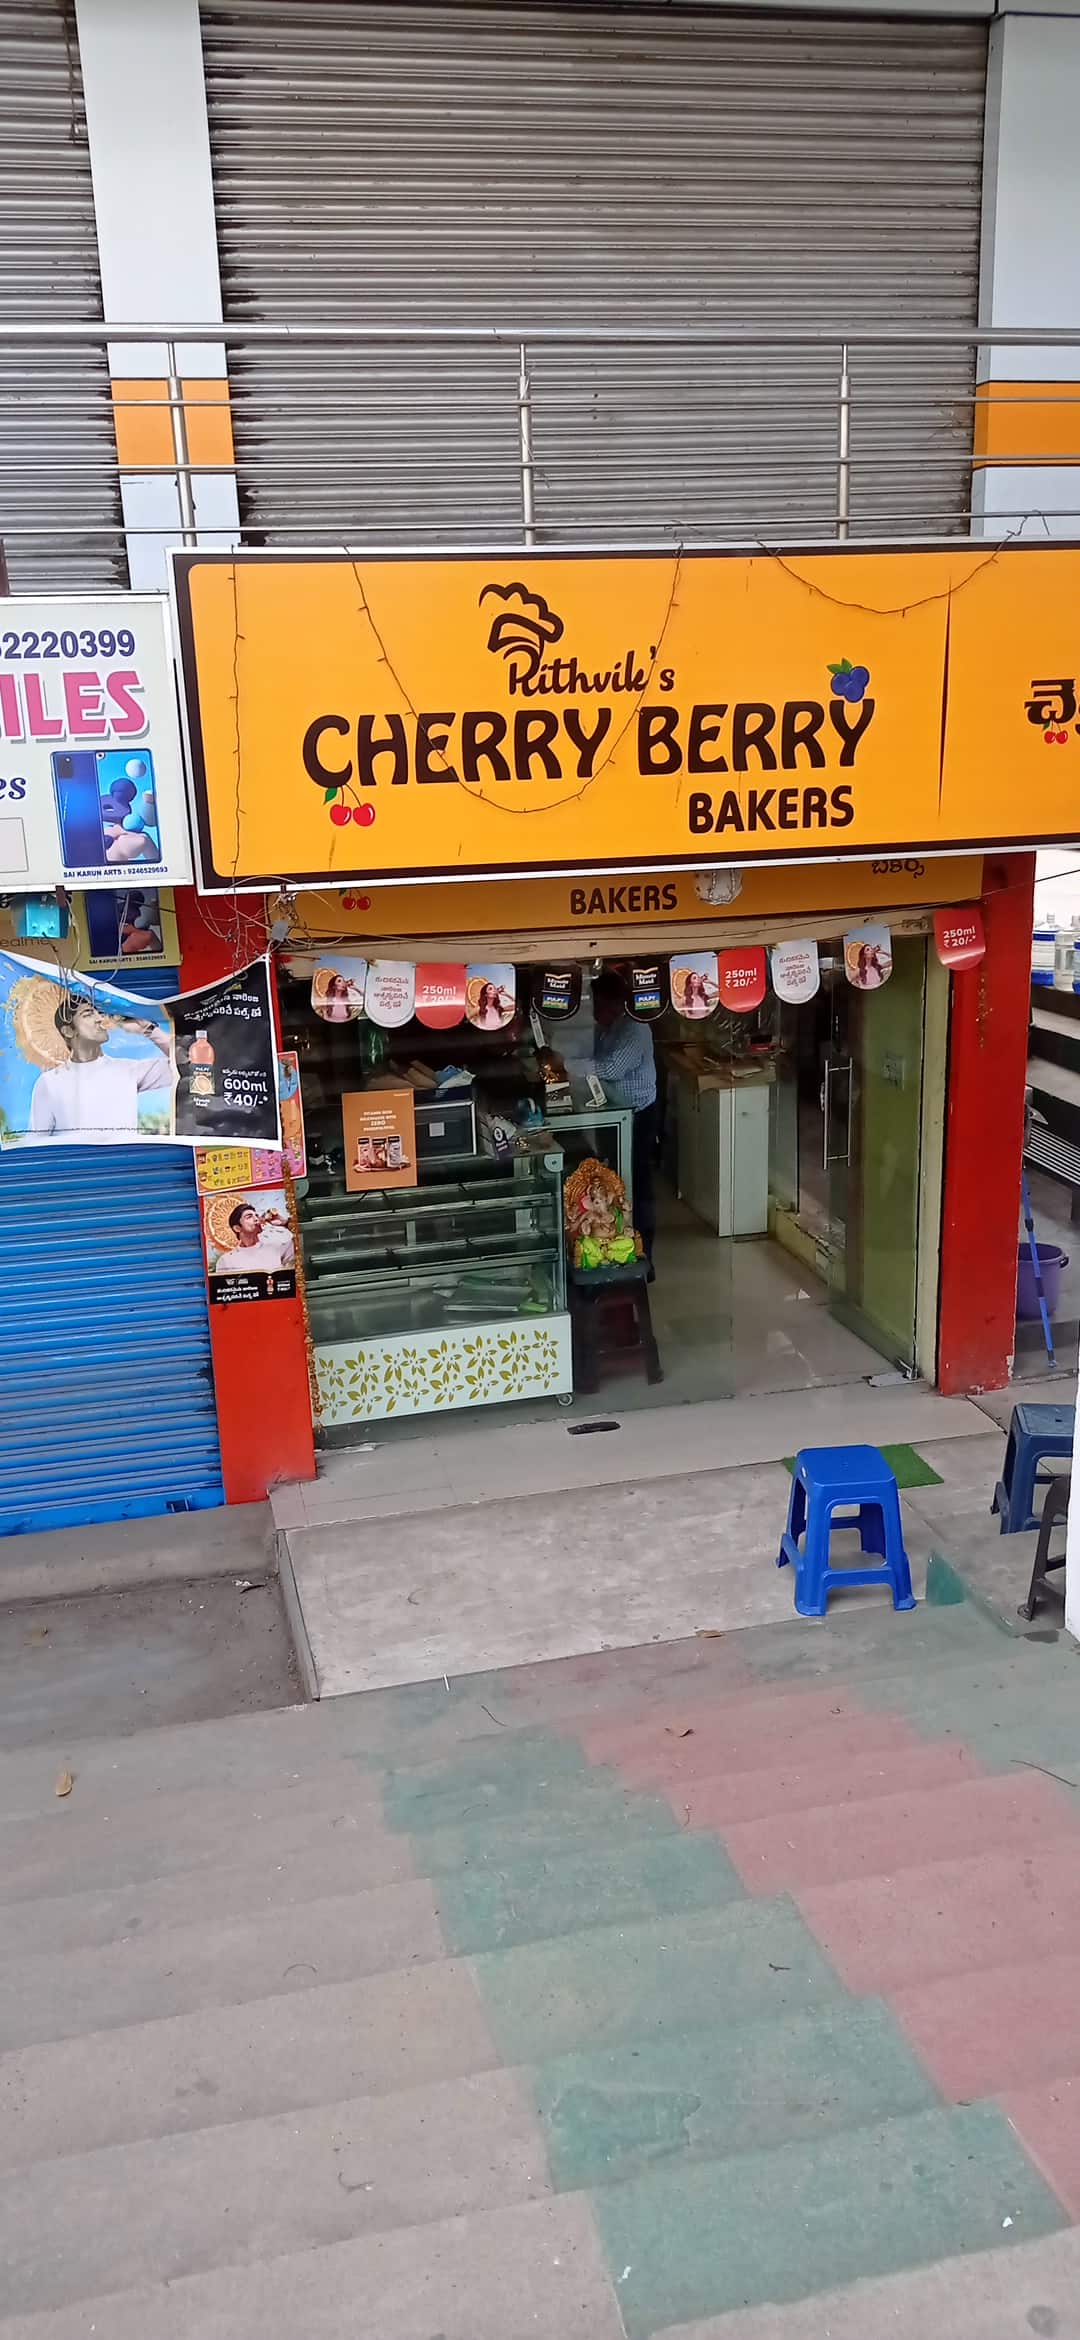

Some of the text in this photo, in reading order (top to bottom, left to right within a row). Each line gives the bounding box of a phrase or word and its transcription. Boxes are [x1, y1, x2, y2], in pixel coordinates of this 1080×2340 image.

[0, 629, 136, 660] 2220399
[508, 643, 676, 698] Rithvik's
[302, 698, 876, 789] CHERRY BERRY
[688, 784, 855, 835] BAKERS
[103, 868, 122, 876] ARTS
[569, 883, 679, 916] BAKERS
[943, 926, 977, 939] 250ml
[725, 967, 758, 978] 250ml
[422, 985, 457, 996] 250ml
[223, 1078, 268, 1092] 600ml
